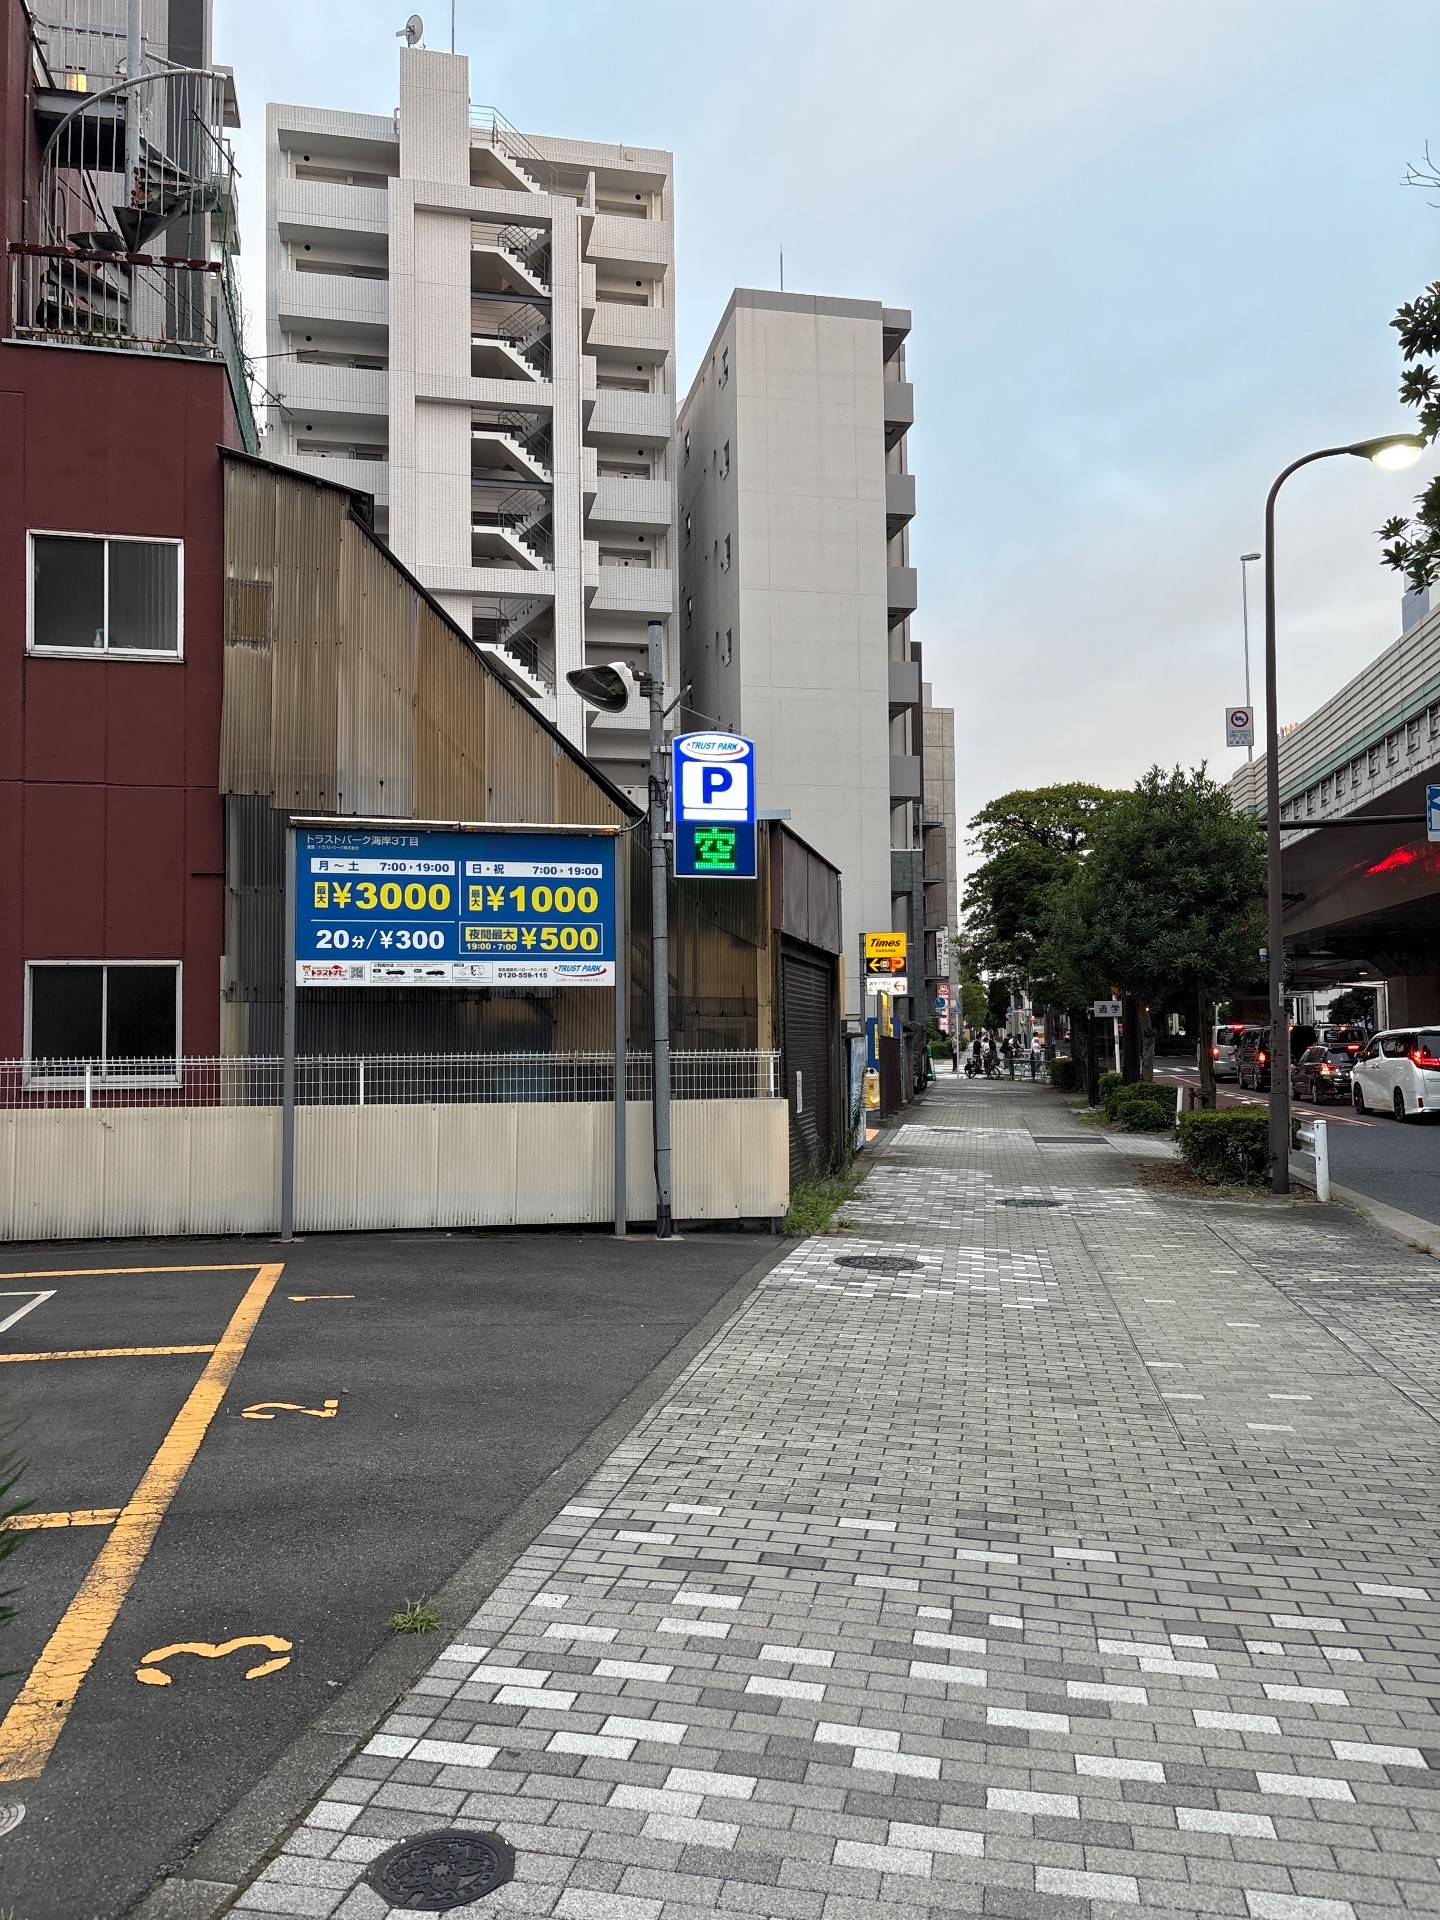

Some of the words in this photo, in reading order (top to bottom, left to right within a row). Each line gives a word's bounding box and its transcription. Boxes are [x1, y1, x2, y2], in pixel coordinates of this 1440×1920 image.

[691, 741, 716, 750] TRUST
[717, 742, 739, 751] PARK
[702, 766, 733, 804] P
[306, 833, 419, 846] トラストパーク海岸3丁目
[694, 827, 735, 869] 空
[379, 862, 407, 872] 7:00
[415, 863, 450, 873] 19:00
[532, 866, 558, 875] 7:00
[567, 867, 599, 876] 19:00
[316, 885, 327, 904] 最大
[332, 882, 451, 911] ¥3000
[471, 889, 481, 907] 最大
[486, 885, 599, 913] ¥1000
[466, 942, 492, 950] 19:00
[497, 943, 517, 951] 7:00
[468, 928, 515, 940] 夜間最大
[521, 927, 599, 950] ¥500
[870, 938, 901, 948] Times
[558, 964, 581, 972] TRUST
[241, 1399, 339, 1420] 2
[134, 1634, 293, 1686] 3
